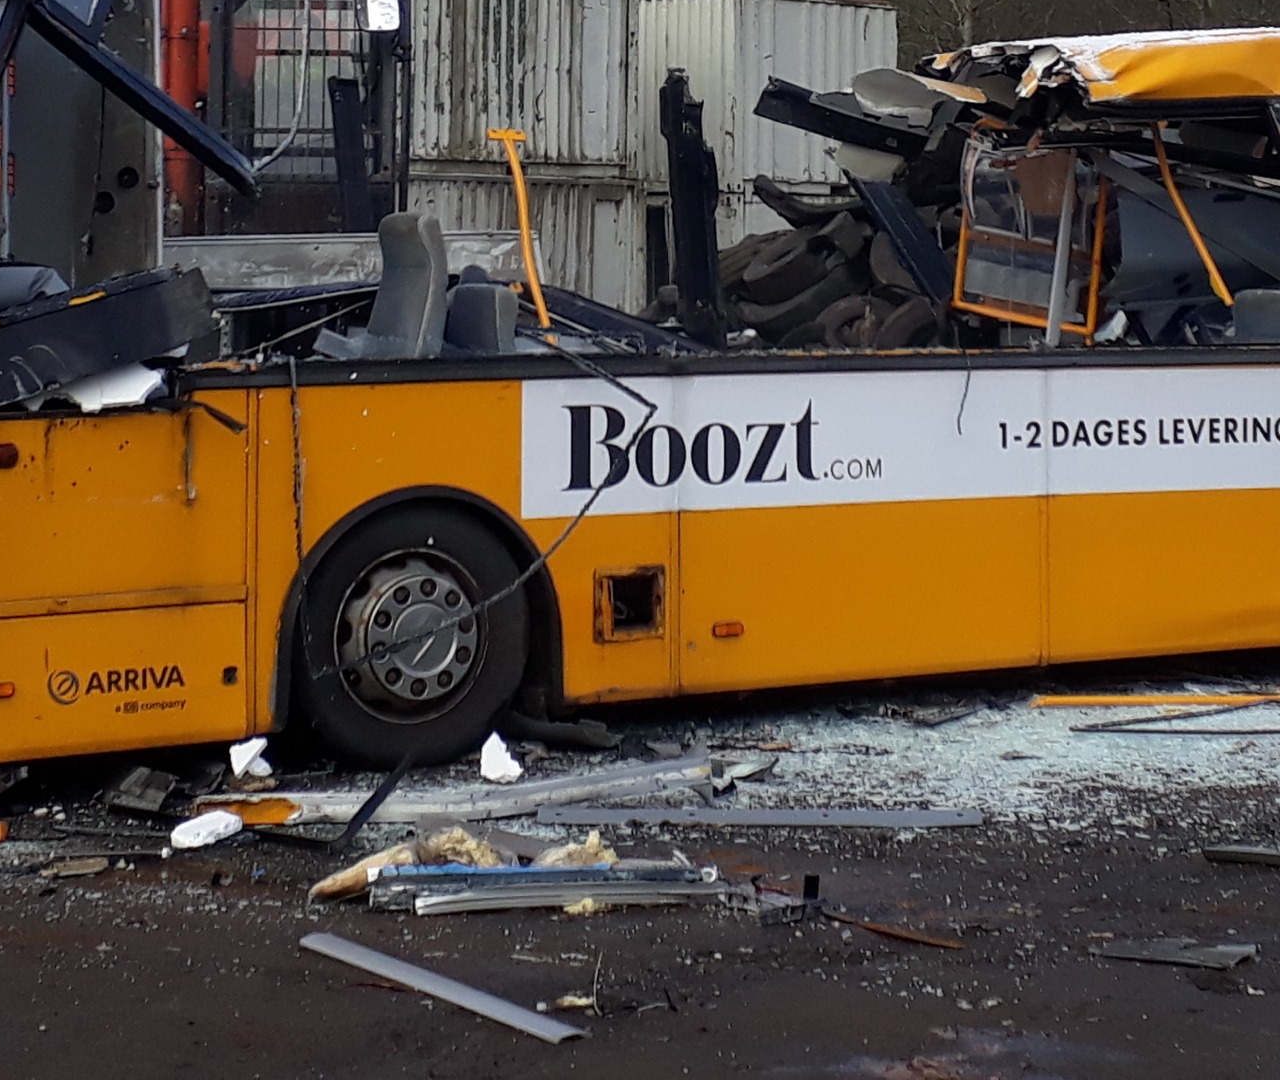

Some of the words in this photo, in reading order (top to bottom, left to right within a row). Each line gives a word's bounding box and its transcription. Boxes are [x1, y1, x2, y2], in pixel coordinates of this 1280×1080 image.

[999, 421, 1043, 449] 1-2
[1052, 418, 1148, 448] DAGES
[85, 665, 185, 694] ARRIVA
[140, 699, 186, 710] company
